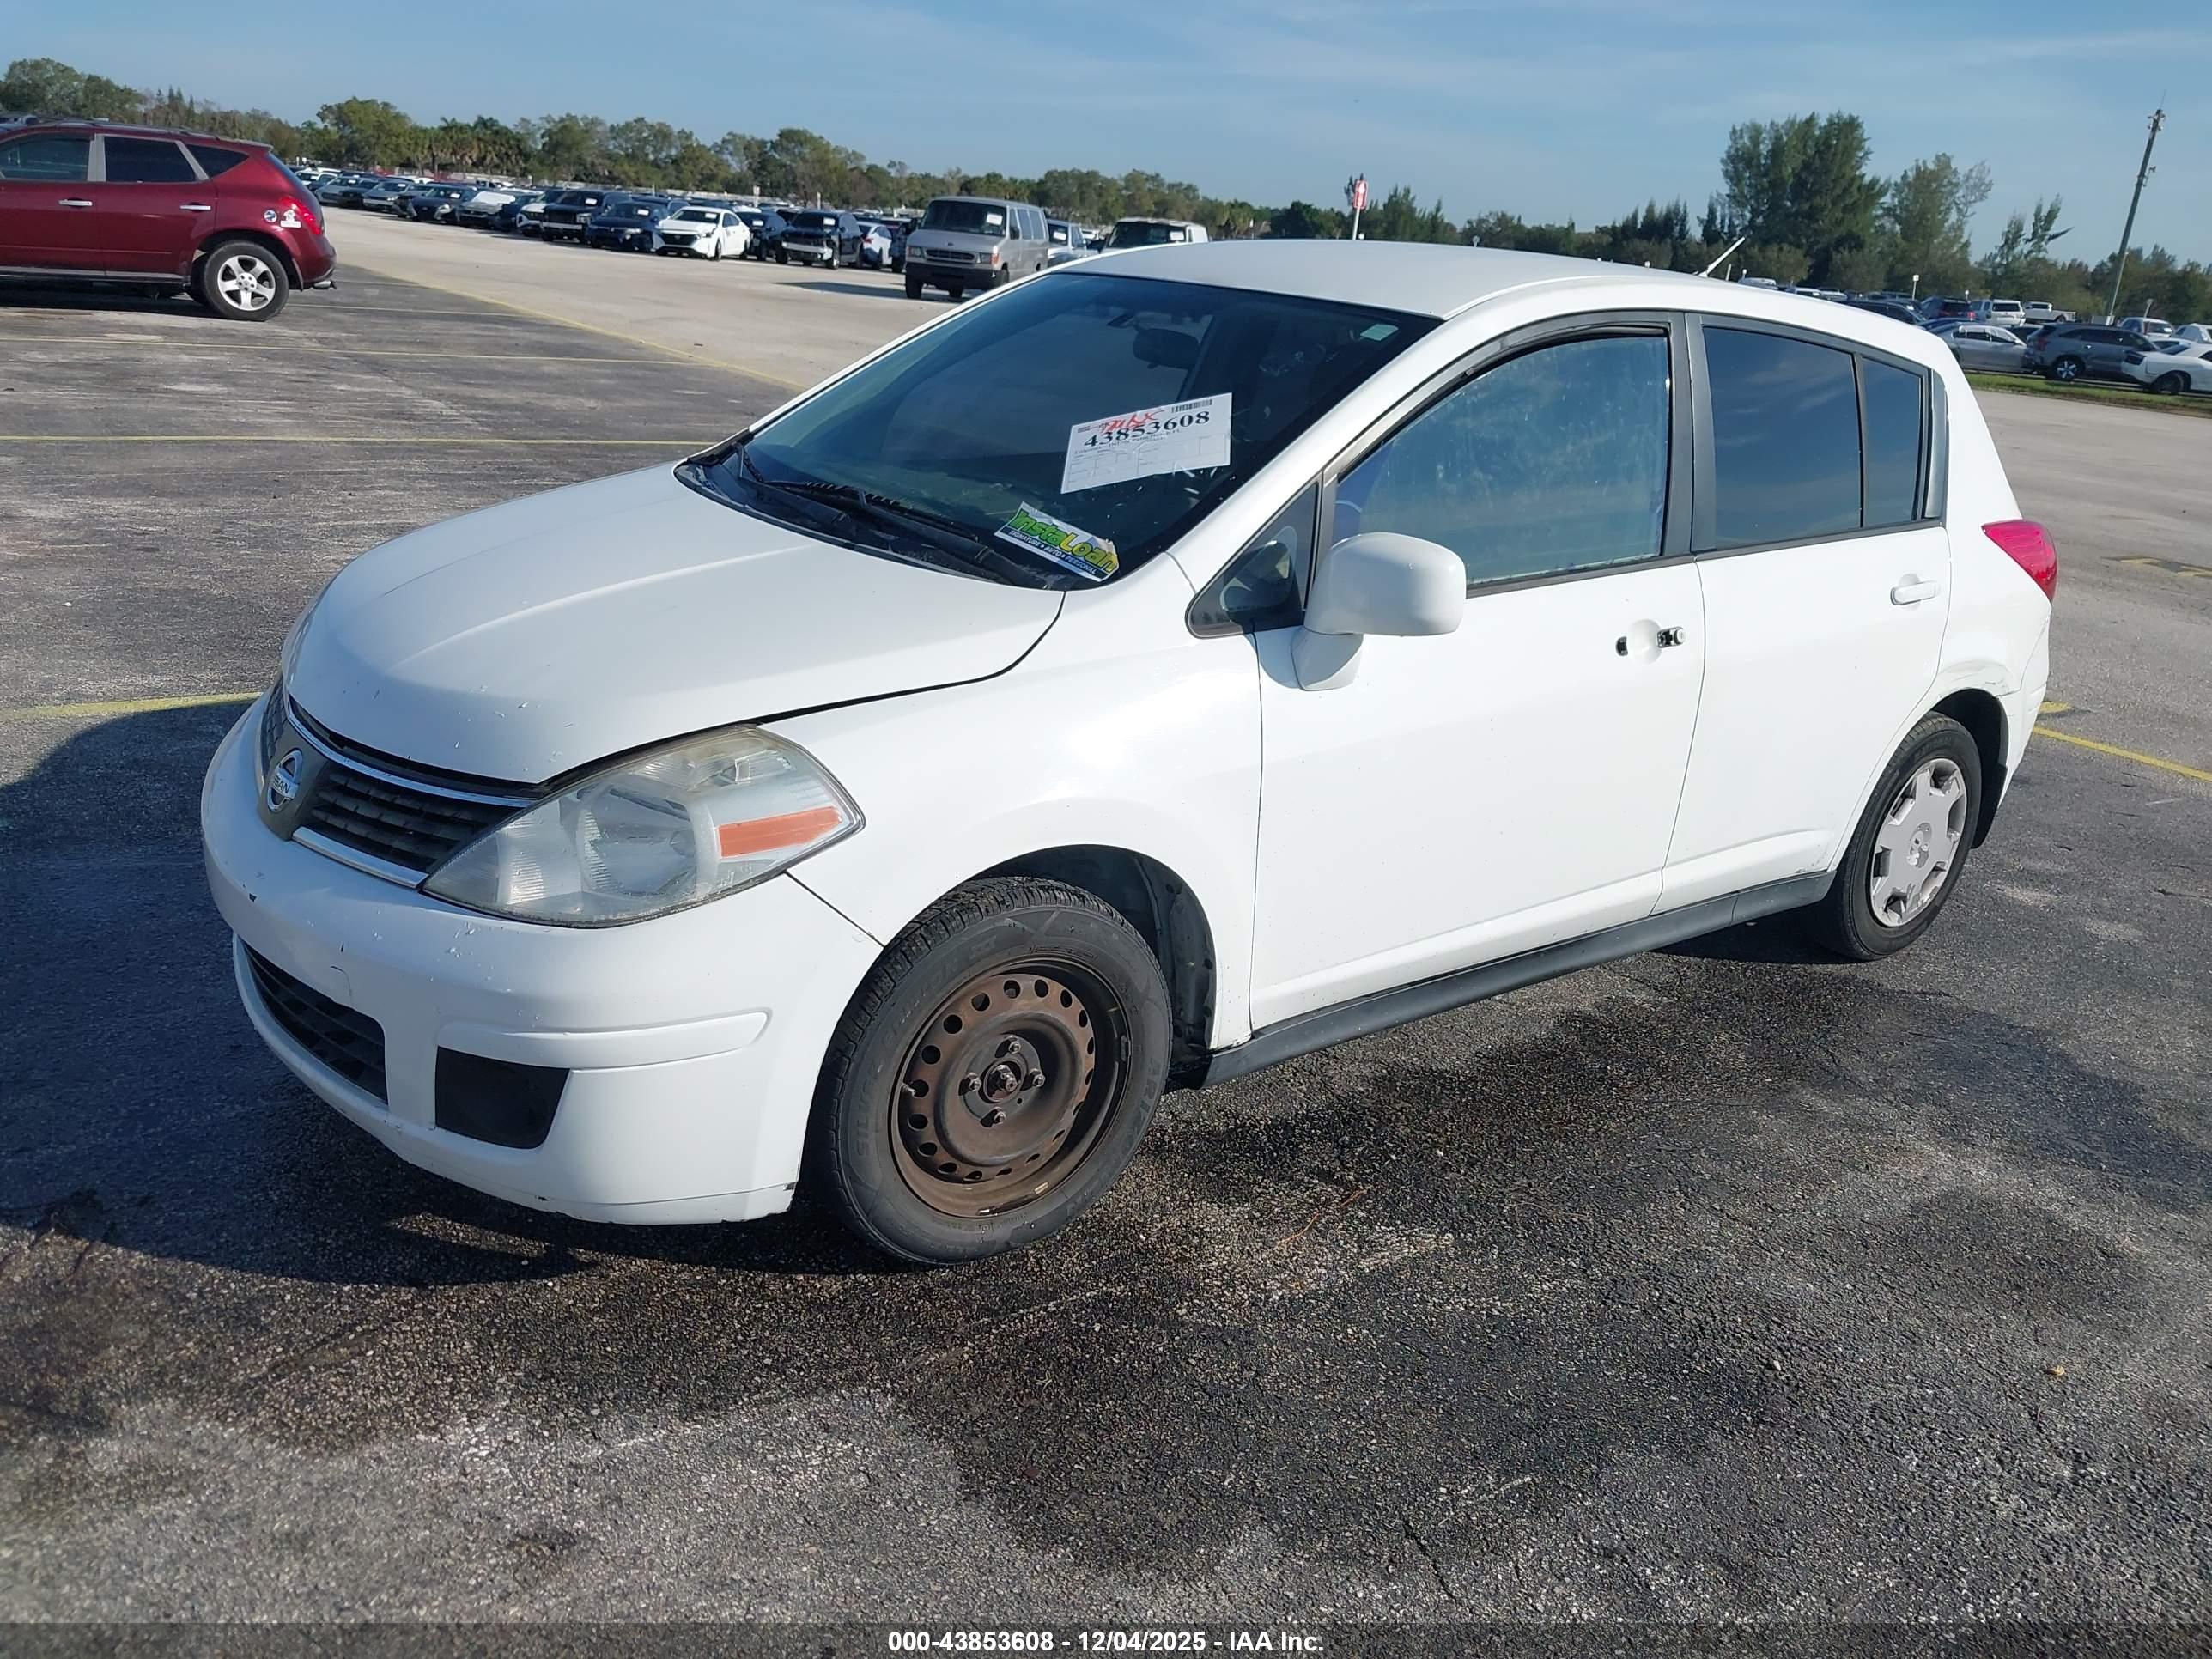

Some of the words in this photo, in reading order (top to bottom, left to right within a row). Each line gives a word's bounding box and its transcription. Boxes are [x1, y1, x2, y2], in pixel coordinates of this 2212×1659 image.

[1084, 410, 1211, 447] 43853608
[1008, 530, 1042, 548] SIGNATURE
[1044, 545, 1063, 557] AUTO
[1064, 554, 1098, 575] PERSONAL
